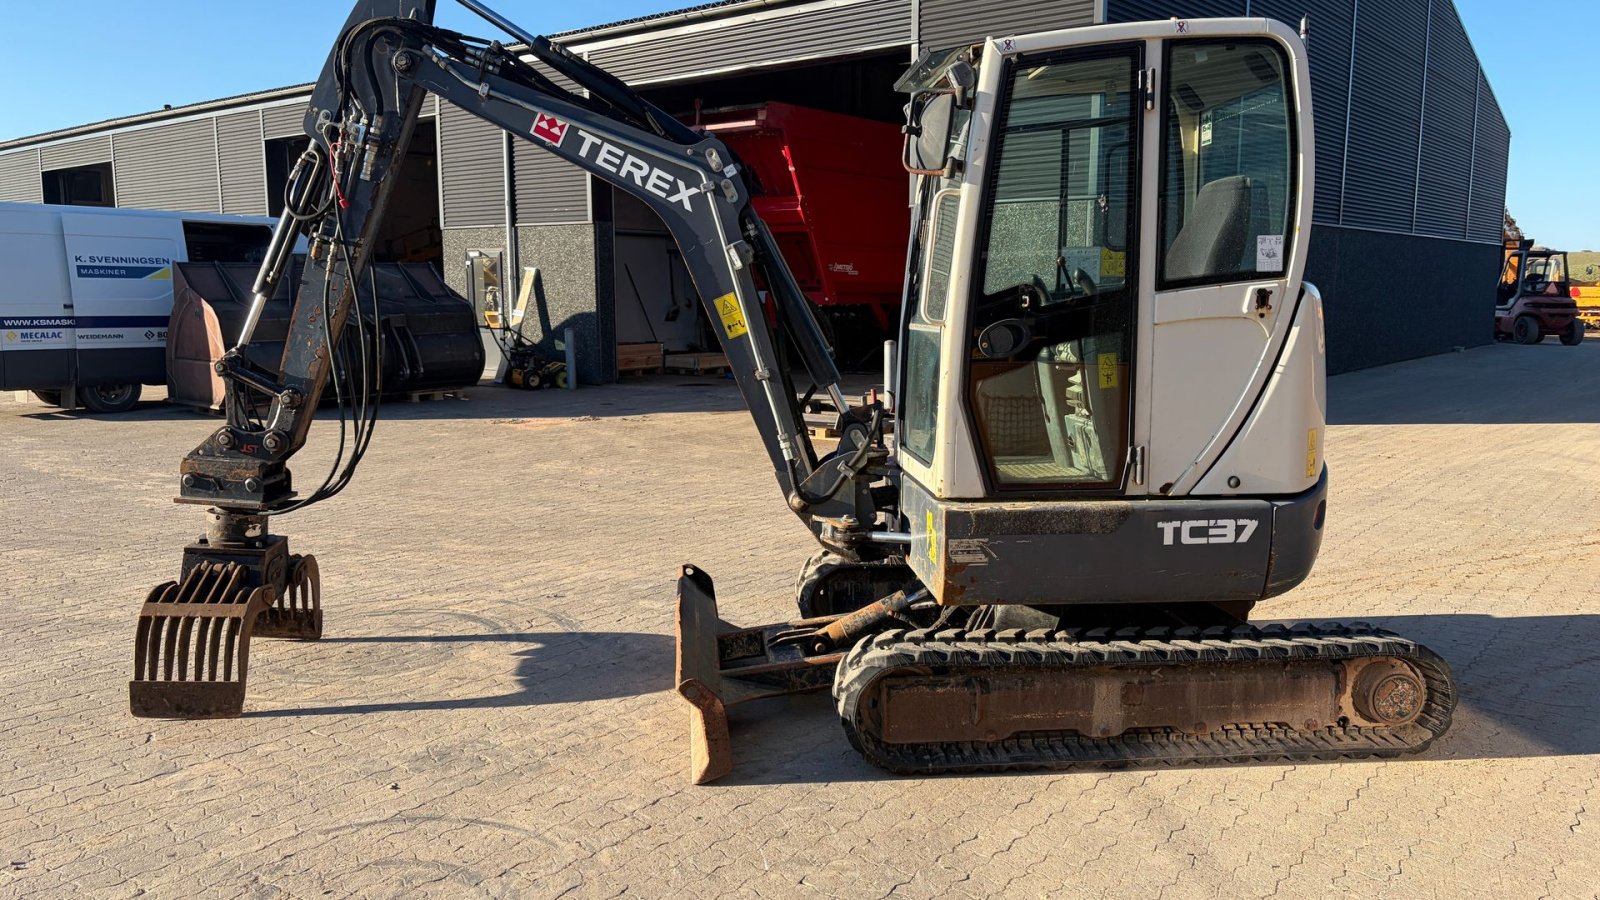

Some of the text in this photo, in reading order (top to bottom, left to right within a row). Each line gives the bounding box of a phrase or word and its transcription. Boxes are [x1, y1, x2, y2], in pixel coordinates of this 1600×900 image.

[577, 129, 701, 212] TEREX
[75, 255, 170, 265] K. SVENNINGSEN
[80, 268, 127, 276] MASKINER
[20, 331, 63, 340] MECALAC
[1157, 519, 1259, 545] TC37
